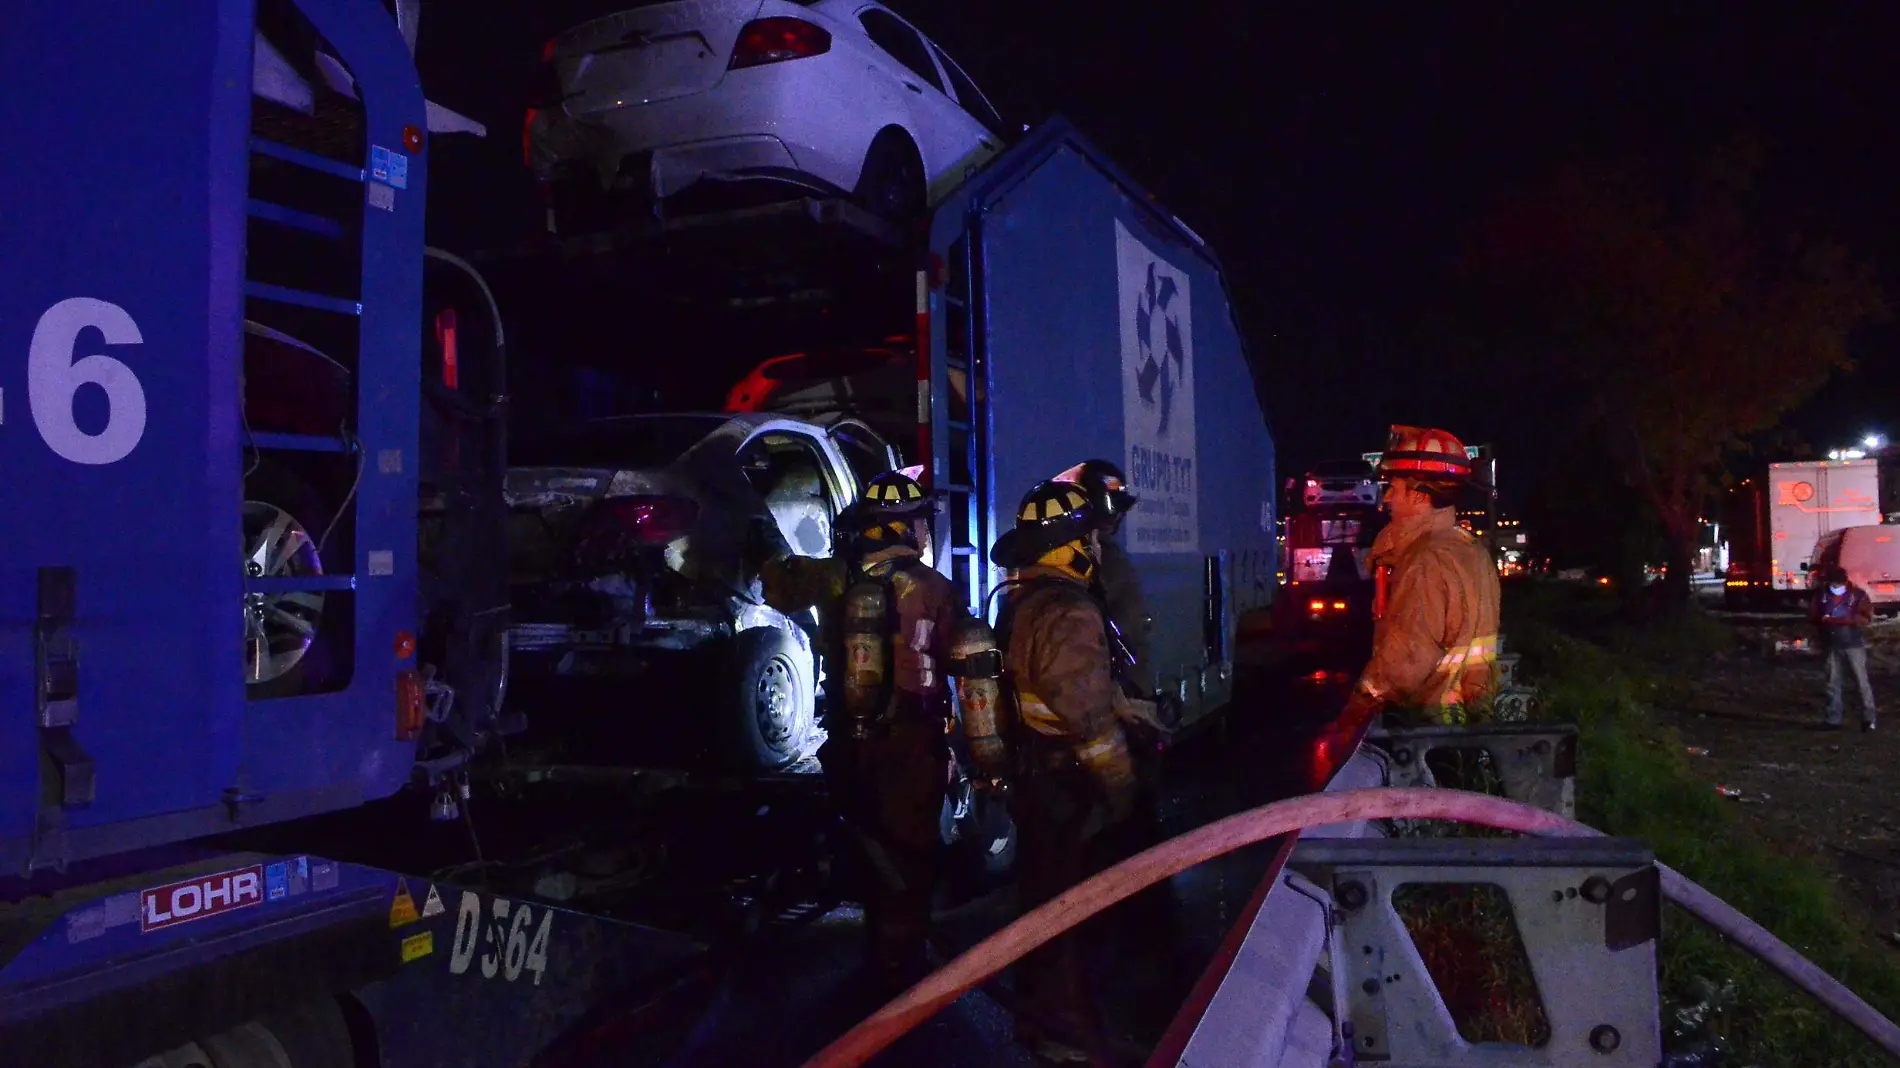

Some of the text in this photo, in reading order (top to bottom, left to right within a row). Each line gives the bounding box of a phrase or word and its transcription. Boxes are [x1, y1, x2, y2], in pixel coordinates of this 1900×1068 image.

[0, 297, 147, 465] 6
[1132, 444, 1171, 492] GRUPO
[146, 872, 258, 924] LOHR
